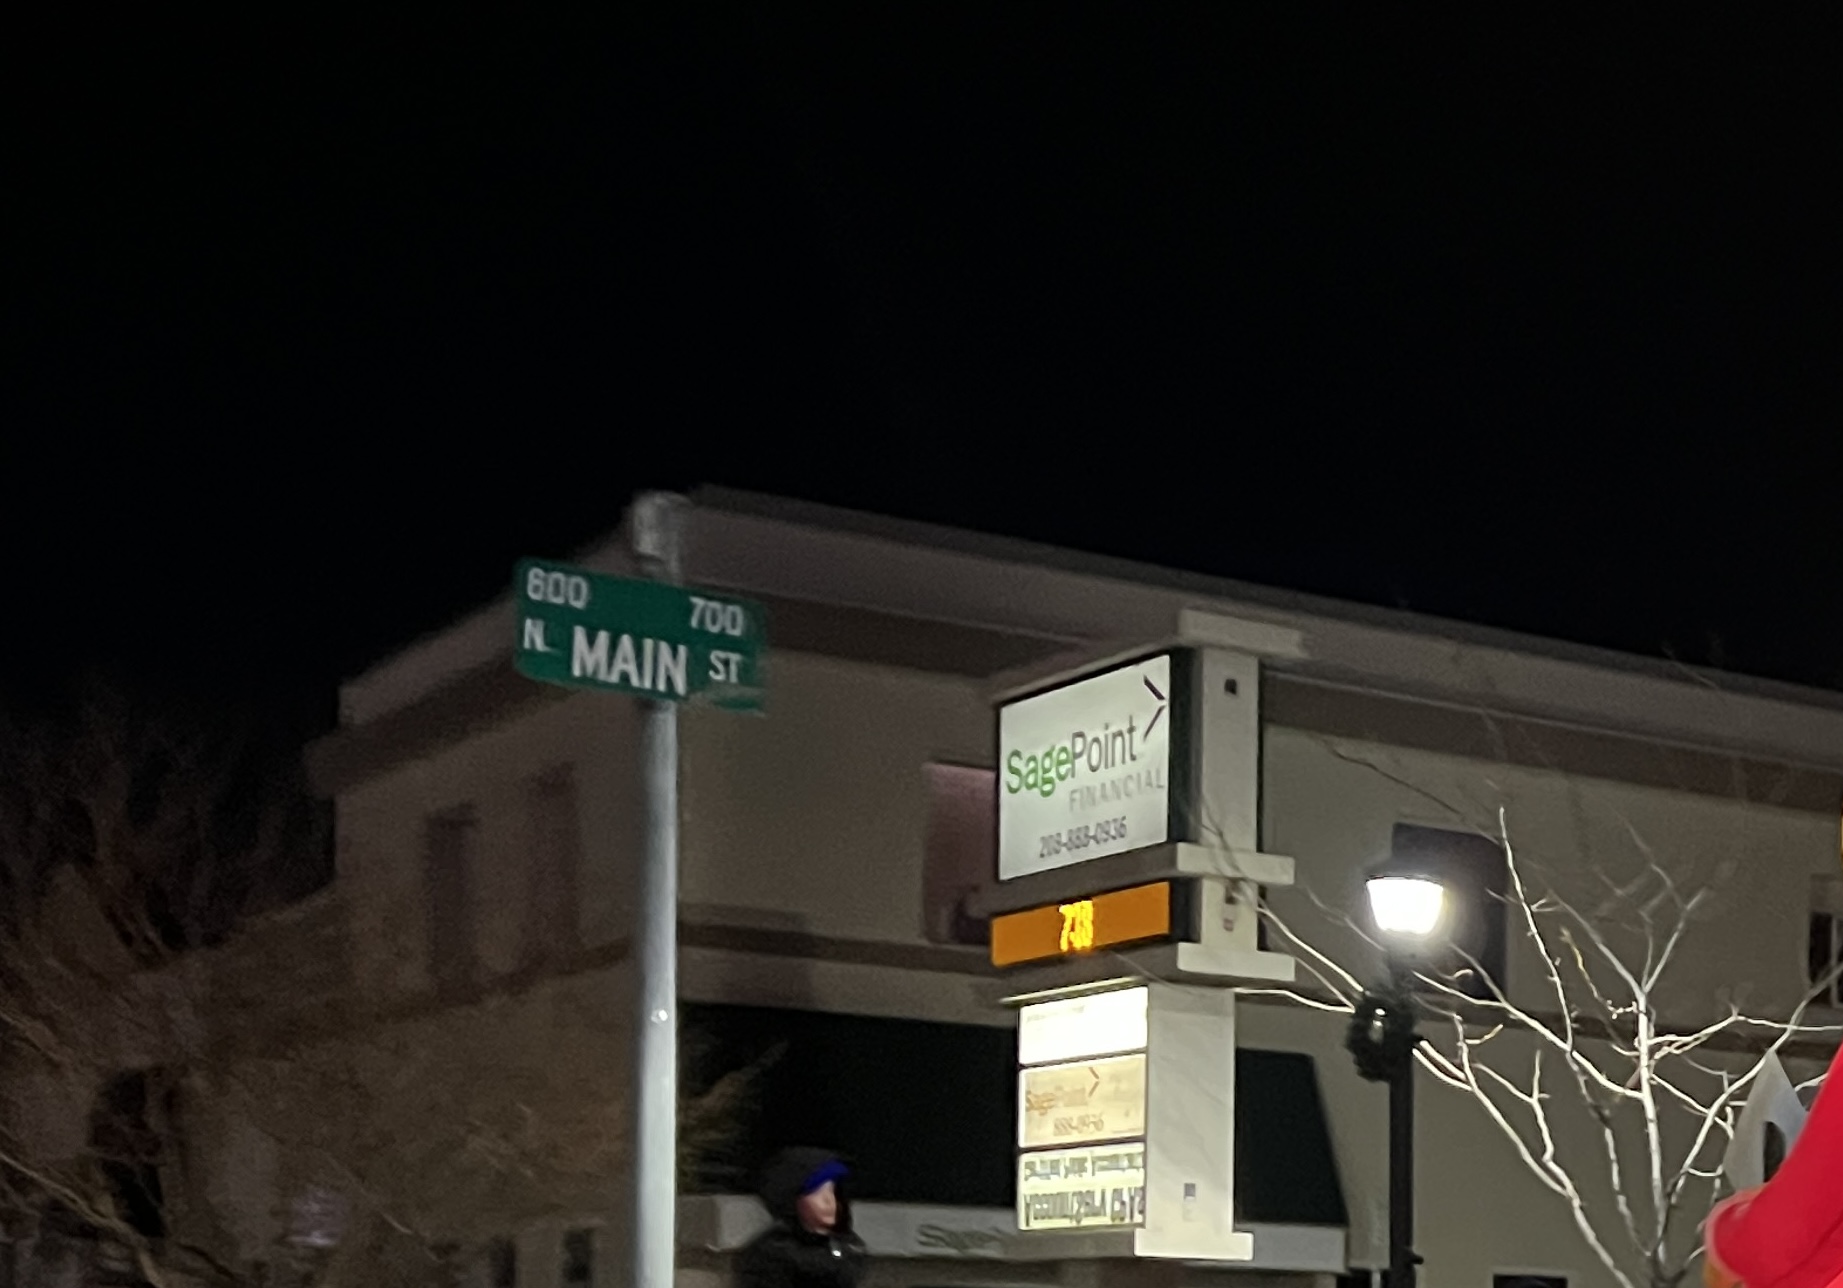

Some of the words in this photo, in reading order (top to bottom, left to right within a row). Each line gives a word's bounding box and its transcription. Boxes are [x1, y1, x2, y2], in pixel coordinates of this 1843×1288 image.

[527, 567, 588, 609] 600
[689, 596, 743, 636] 700
[571, 624, 688, 696] MAIN
[708, 650, 743, 684] ST
[1005, 714, 1137, 798] SagePoint
[1068, 768, 1166, 813] FINANCIAL
